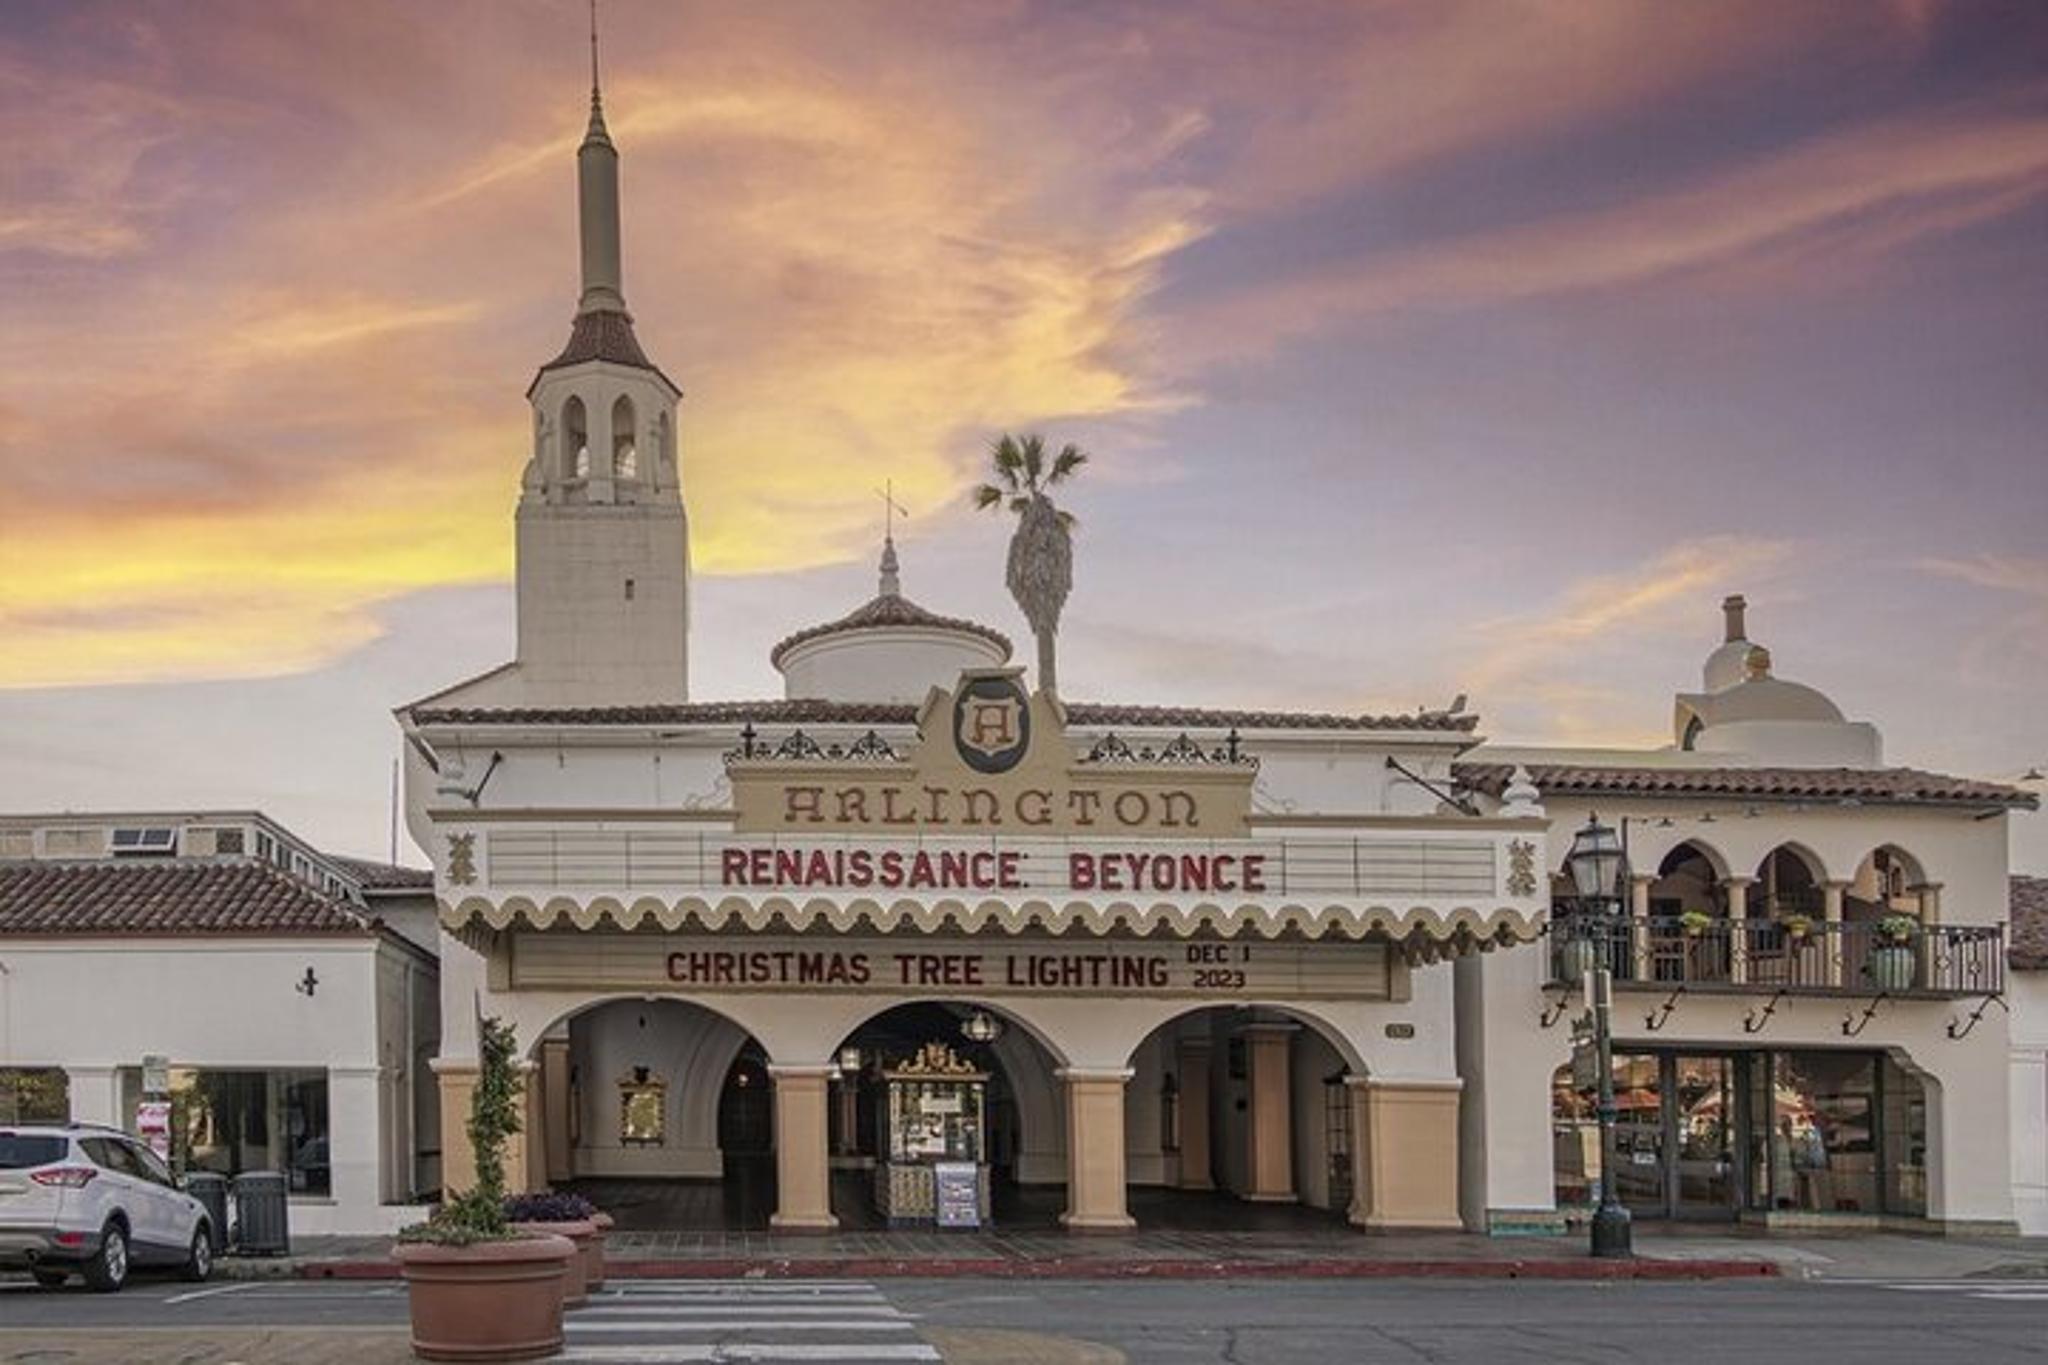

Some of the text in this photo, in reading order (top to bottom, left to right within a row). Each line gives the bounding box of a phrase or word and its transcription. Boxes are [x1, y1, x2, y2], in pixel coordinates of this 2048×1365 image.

[784, 785, 1200, 828] ARLINGTON
[1069, 852, 1267, 892] BEYONCE
[667, 952, 1169, 988] CHRISTMAS TREE LIGHTING
[1187, 944, 1229, 964] DEC
[1193, 969, 1246, 989] 2023
